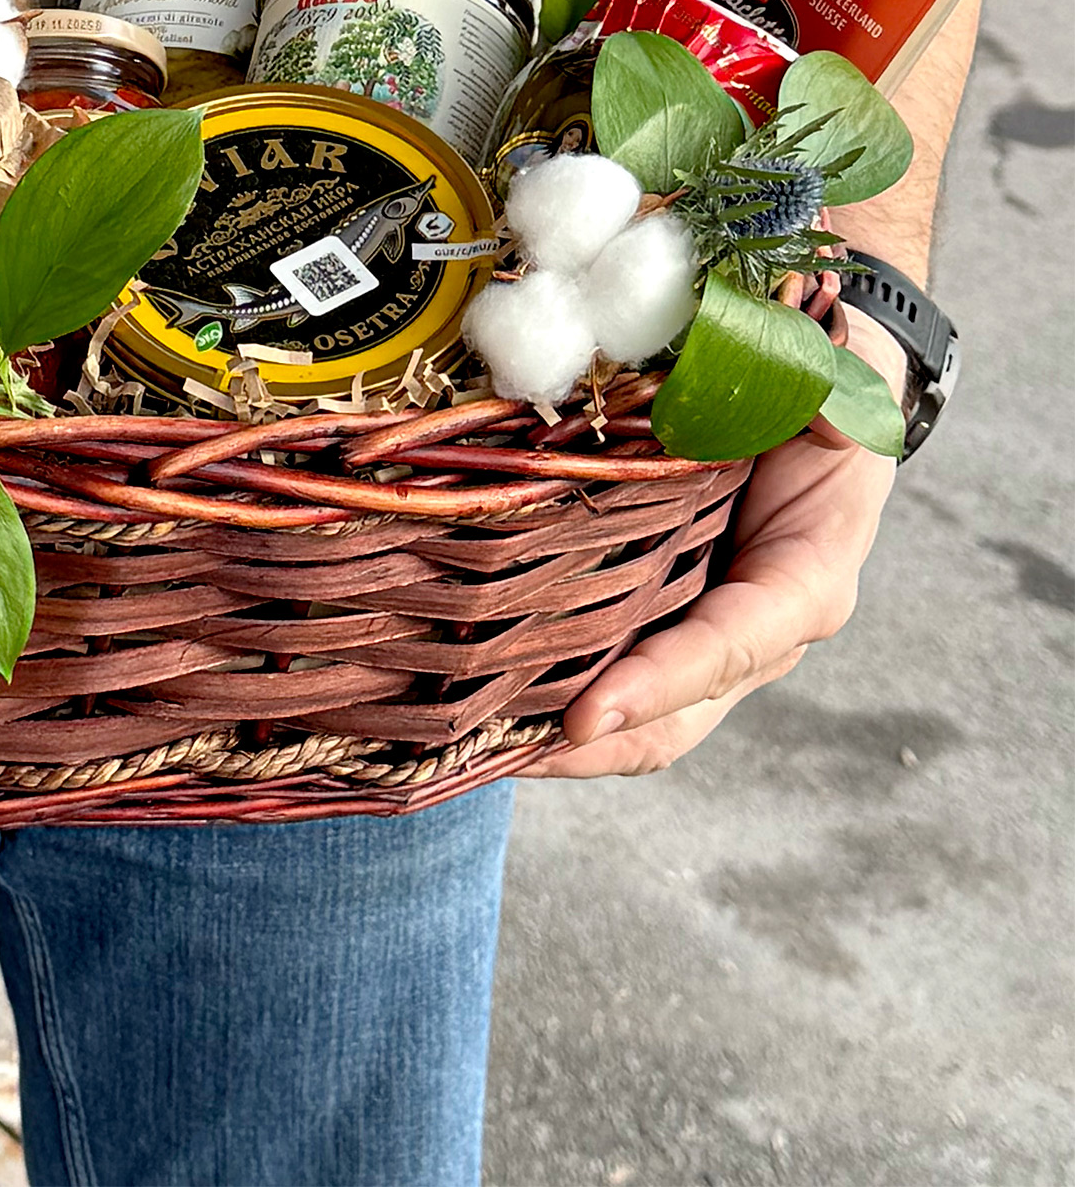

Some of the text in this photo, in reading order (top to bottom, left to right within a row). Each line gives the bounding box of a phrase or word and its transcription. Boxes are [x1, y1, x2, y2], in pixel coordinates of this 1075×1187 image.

[186, 181, 360, 277] АСТРАХАНСКАЯ ИКРА
[313, 292, 417, 352] OSETRA
